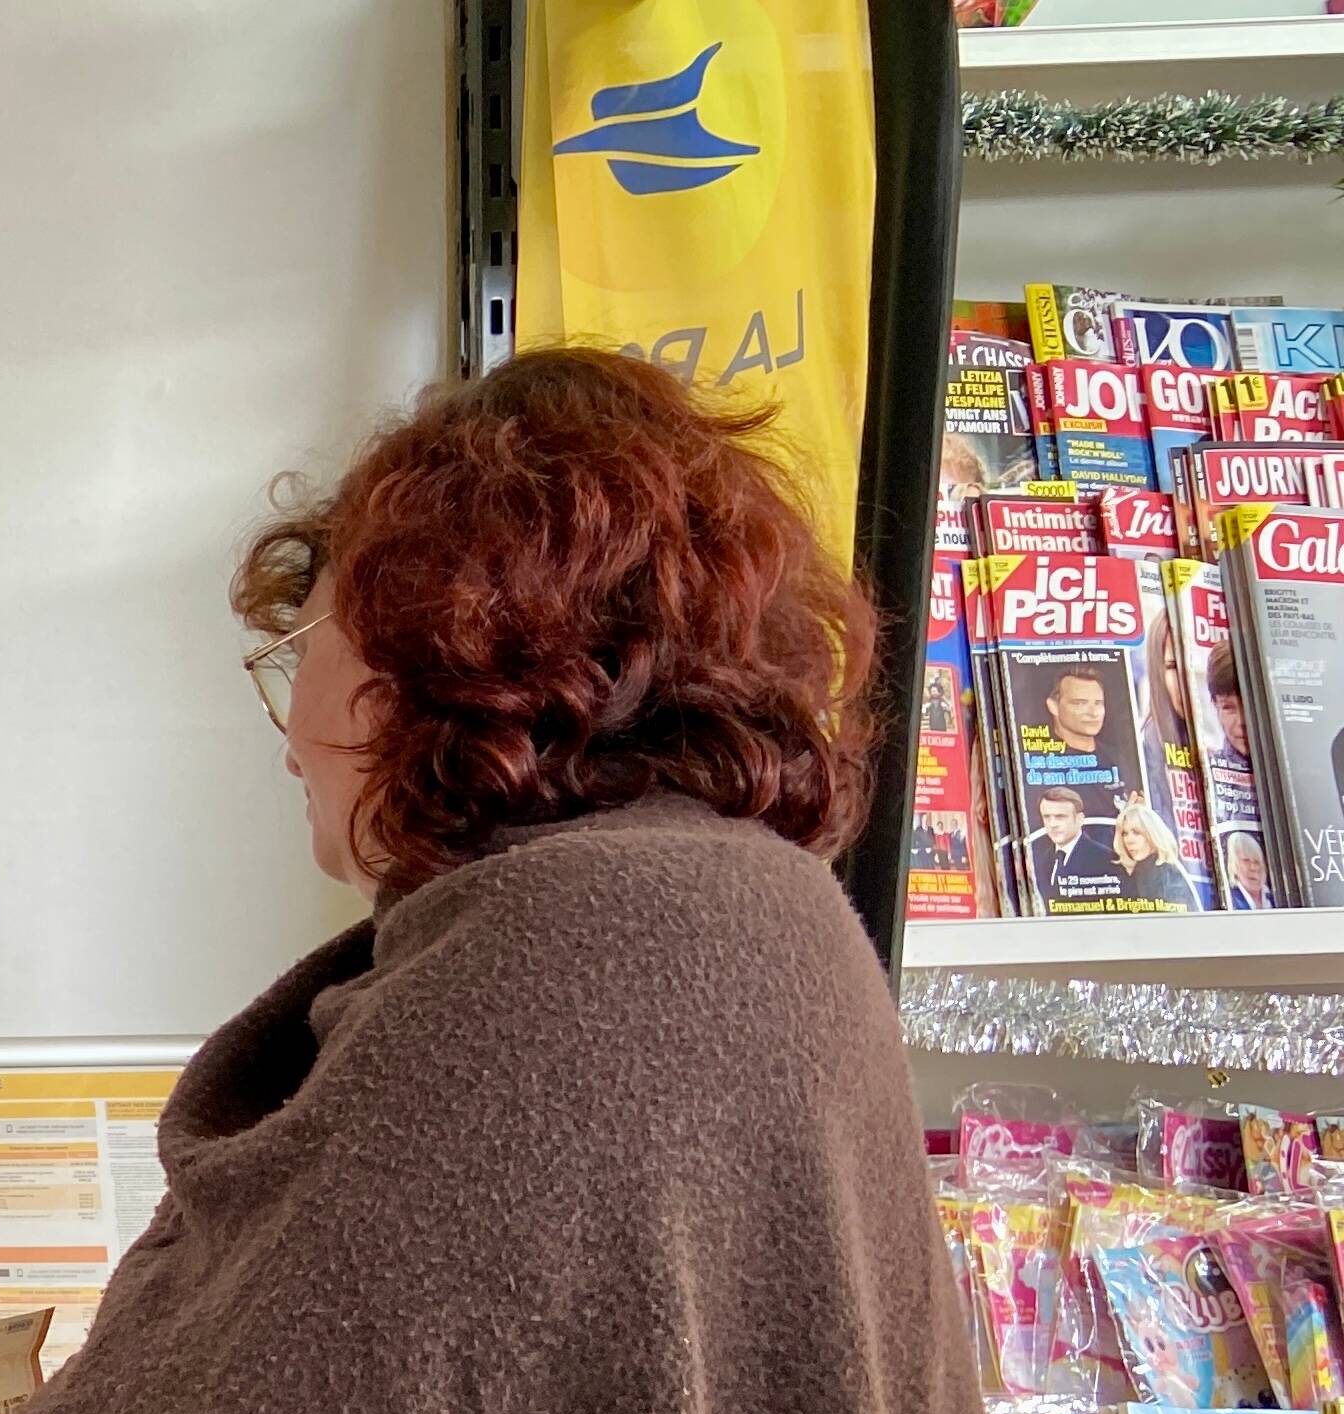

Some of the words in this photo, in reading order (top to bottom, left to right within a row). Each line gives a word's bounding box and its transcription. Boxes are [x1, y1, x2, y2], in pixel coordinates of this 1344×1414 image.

[961, 370, 1003, 383] LETIZIA
[948, 383, 962, 395] ET
[965, 383, 1005, 396] FELIPE
[946, 409, 980, 421] VINGT
[982, 409, 1007, 422] ANS
[946, 420, 1001, 433] D'AMOUR
[1072, 471, 1100, 481] DAVID
[1102, 472, 1147, 484] HALLYDAY
[1002, 507, 1097, 530] Intimité
[996, 529, 1101, 553] Dimanch
[1036, 556, 1097, 600] ici
[1003, 589, 1137, 635] Paris
[1021, 725, 1050, 737] David
[1023, 738, 1066, 753] Hallyday
[1024, 753, 1045, 768] Les
[1046, 754, 1097, 767] dessous
[1026, 769, 1042, 785] de
[1044, 772, 1065, 784] son
[1049, 899, 1104, 913] Emmanuel
[1105, 899, 1115, 911] &
[1116, 898, 1154, 914] Brigitte
[1156, 899, 1187, 913] Macron
